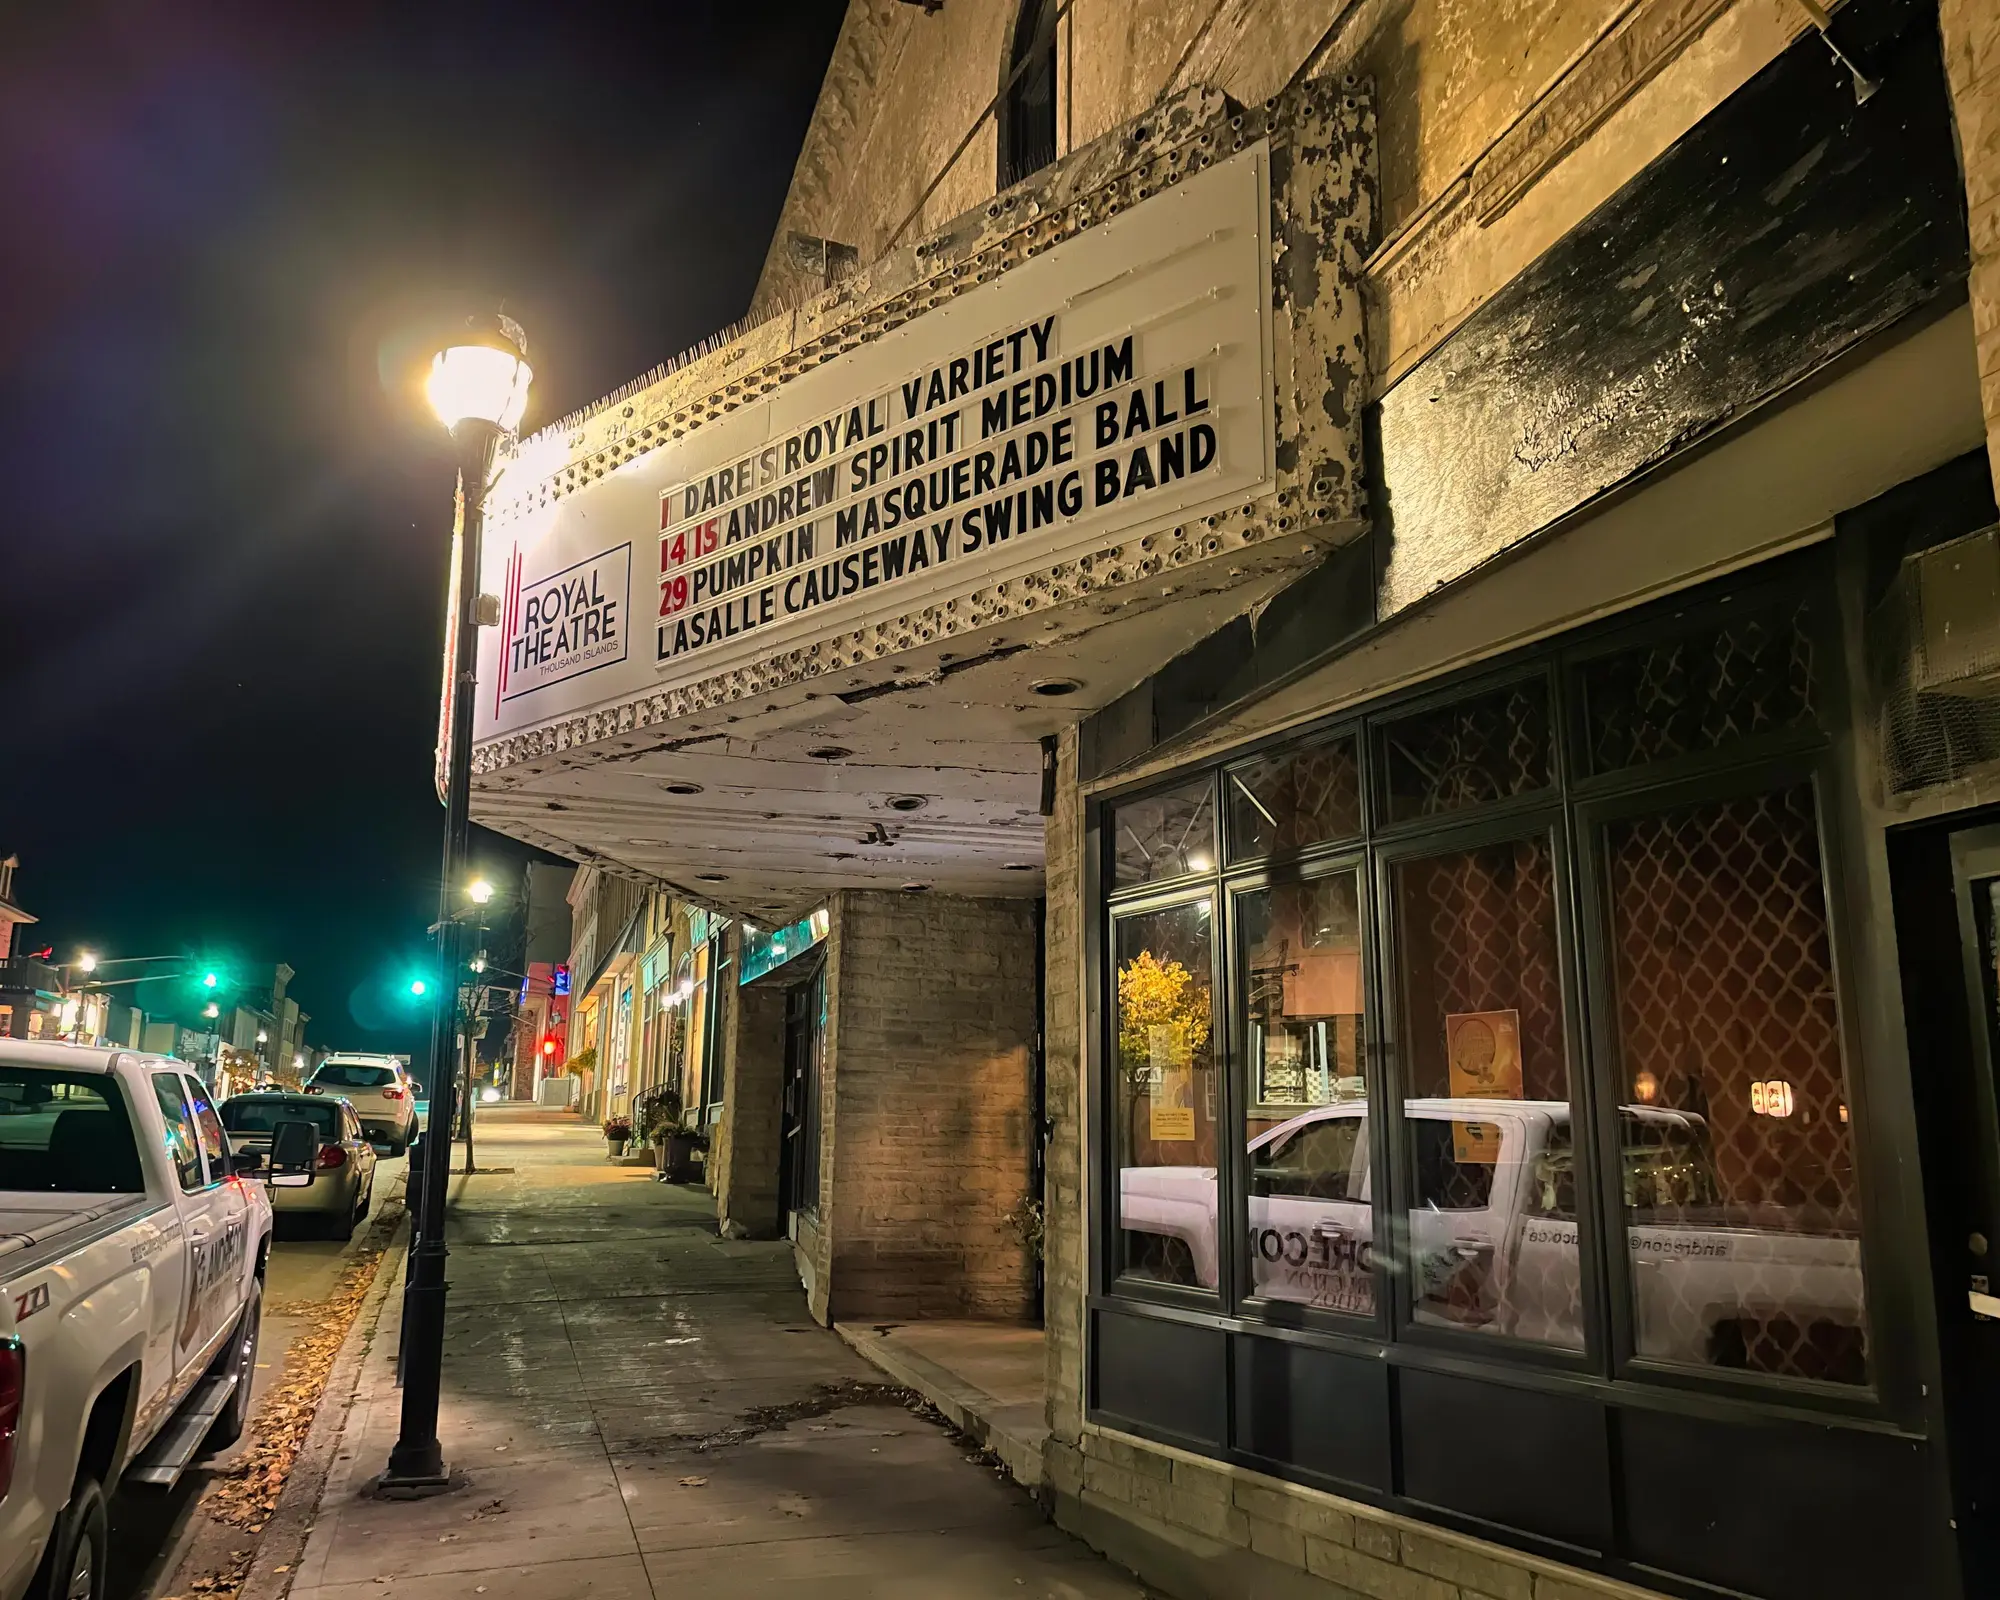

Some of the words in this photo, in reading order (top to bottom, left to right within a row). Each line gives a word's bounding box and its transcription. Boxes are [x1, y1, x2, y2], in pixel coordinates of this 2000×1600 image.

[661, 533, 687, 573] 14
[695, 518, 718, 558] 15
[726, 464, 836, 546] ANDREW
[851, 410, 960, 493] SPIRIT
[982, 335, 1133, 440] MEDIUM
[785, 400, 884, 475] ROYAL
[902, 315, 1056, 420] VARIETY
[657, 585, 774, 661] LASALLE
[784, 518, 953, 613] CAUSEWAY
[962, 470, 1082, 554] SWING
[1095, 424, 1216, 507] BAND
[659, 575, 688, 616] 29
[693, 523, 813, 604] PUMPKIN
[836, 417, 1072, 549] MASQUERADE
[1095, 367, 1209, 450] BALL
[512, 601, 617, 673] THEATRE
[524, 569, 605, 634] ROYAL
[540, 653, 581, 676] THOUSAND
[583, 640, 619, 660] ISLANDS
